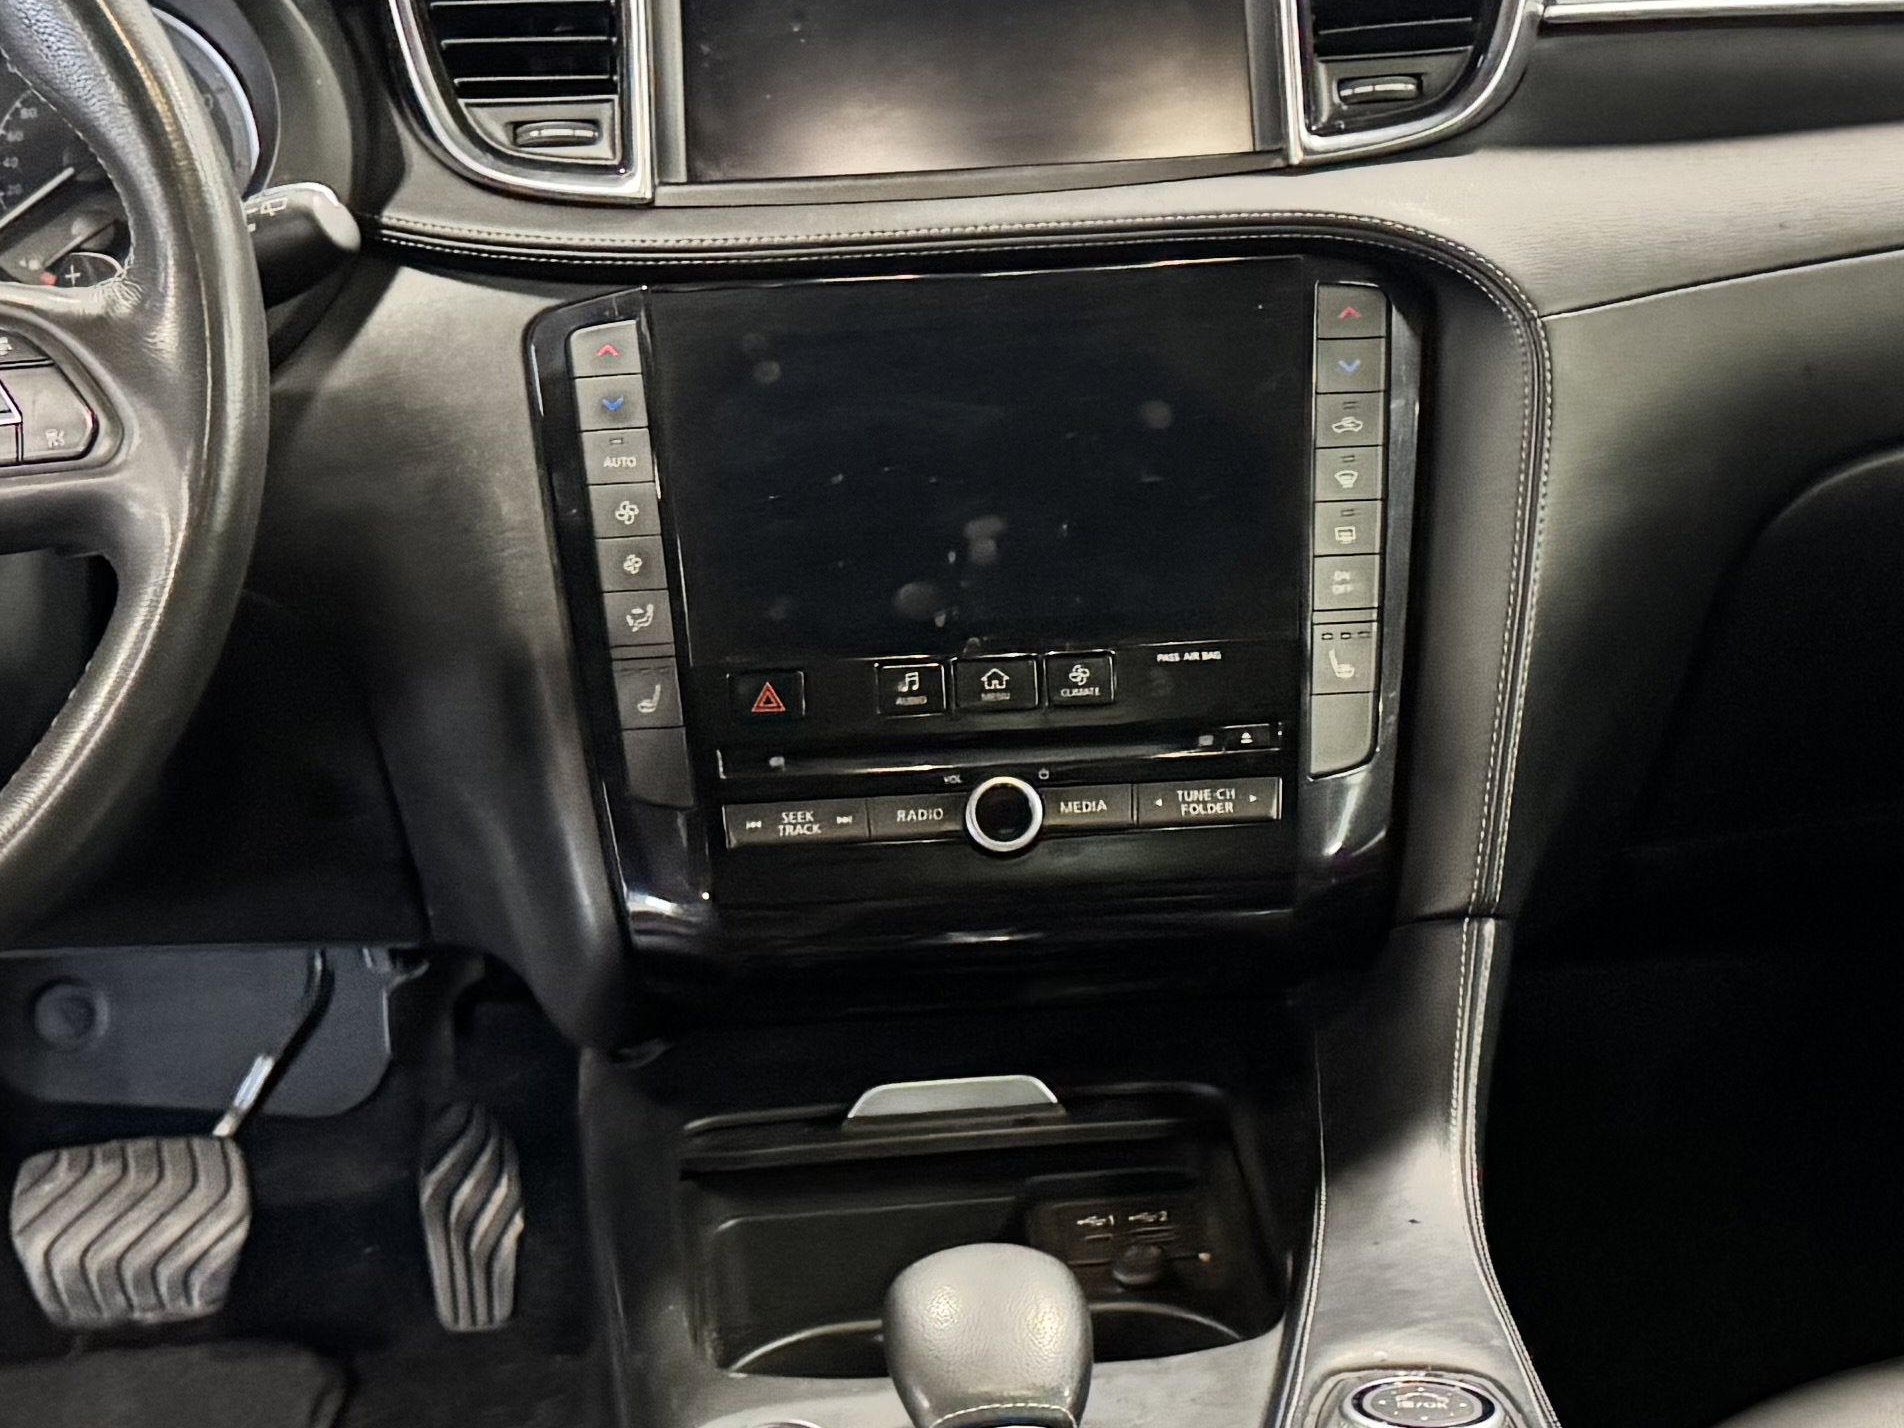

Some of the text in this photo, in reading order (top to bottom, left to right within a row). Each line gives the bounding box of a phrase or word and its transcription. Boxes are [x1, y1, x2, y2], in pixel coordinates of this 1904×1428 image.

[603, 456, 637, 468] AUTO
[1060, 800, 1108, 814] MEDIA
[1180, 802, 1234, 816] FOLDER
[781, 811, 815, 823] SEEK
[896, 808, 944, 823] RADIO
[778, 824, 822, 837] TRACK
